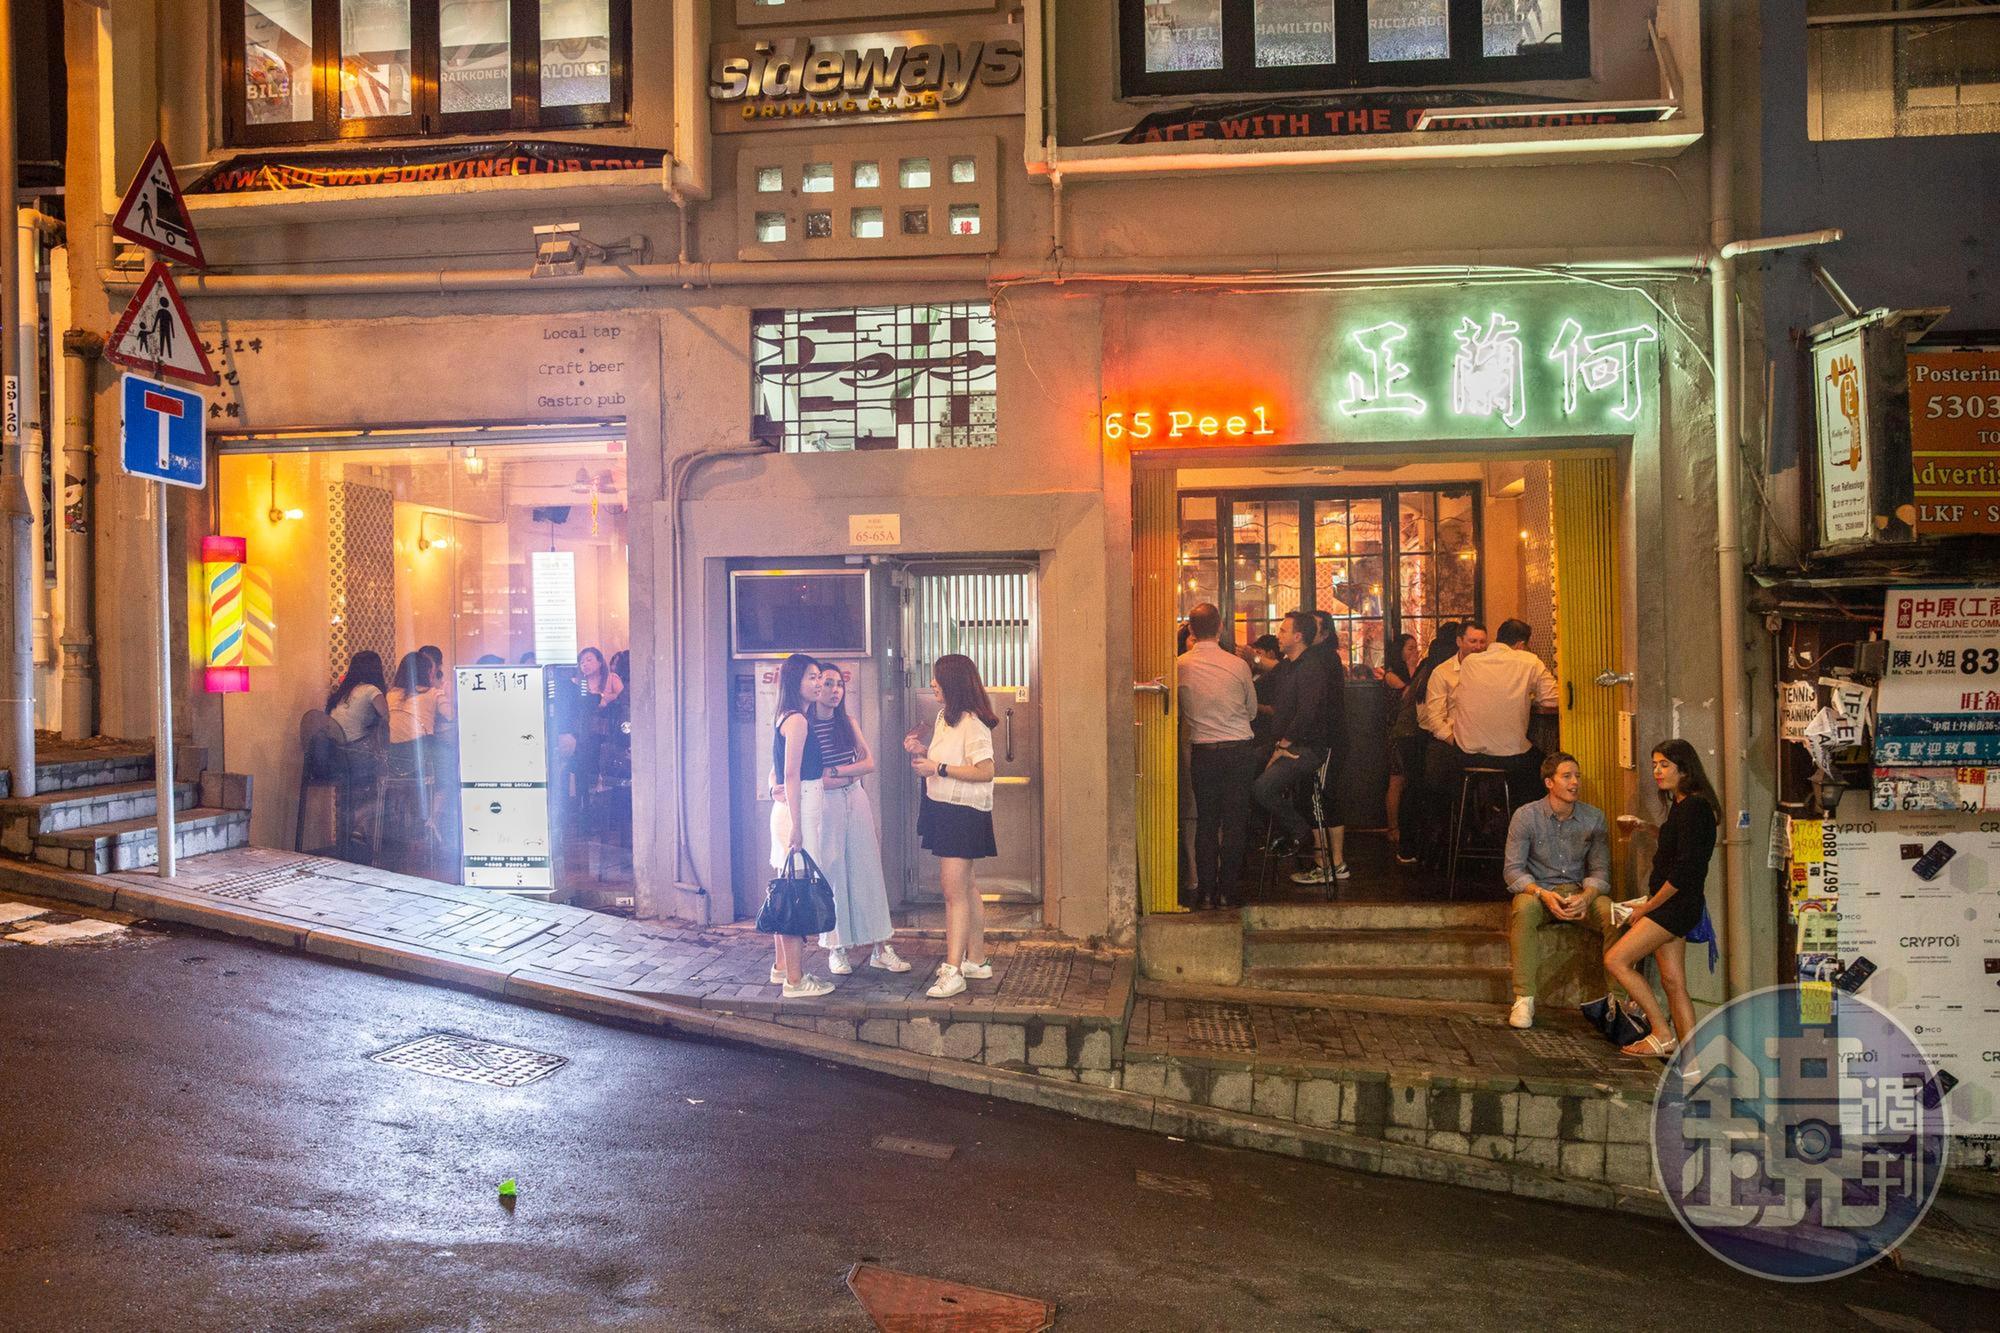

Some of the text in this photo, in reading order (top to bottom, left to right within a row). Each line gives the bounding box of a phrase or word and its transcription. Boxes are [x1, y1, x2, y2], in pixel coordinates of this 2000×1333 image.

[1256, 21, 1332, 35] HAMILTON
[440, 68, 509, 83] RAIKKONEN
[541, 60, 608, 79] ALONSO
[708, 37, 1023, 104] sideways
[741, 92, 941, 120] DRIVING CLUB
[1219, 113, 1310, 140] WITH
[1325, 108, 1392, 134] THE
[543, 326, 621, 340] Local tap
[538, 360, 625, 375] Craft beer
[6, 380, 17, 433] 39120
[537, 392, 626, 408] Gastro pub
[1105, 405, 1275, 440] 65 Peel
[1912, 461, 2000, 485] dverti
[1920, 504, 1965, 522] LKF
[855, 530, 895, 542] 65-65A
[1914, 620, 1969, 629] CENTALINE
[1892, 649, 1956, 668] 陳小姐
[1822, 823, 1839, 894] 6677 8804
